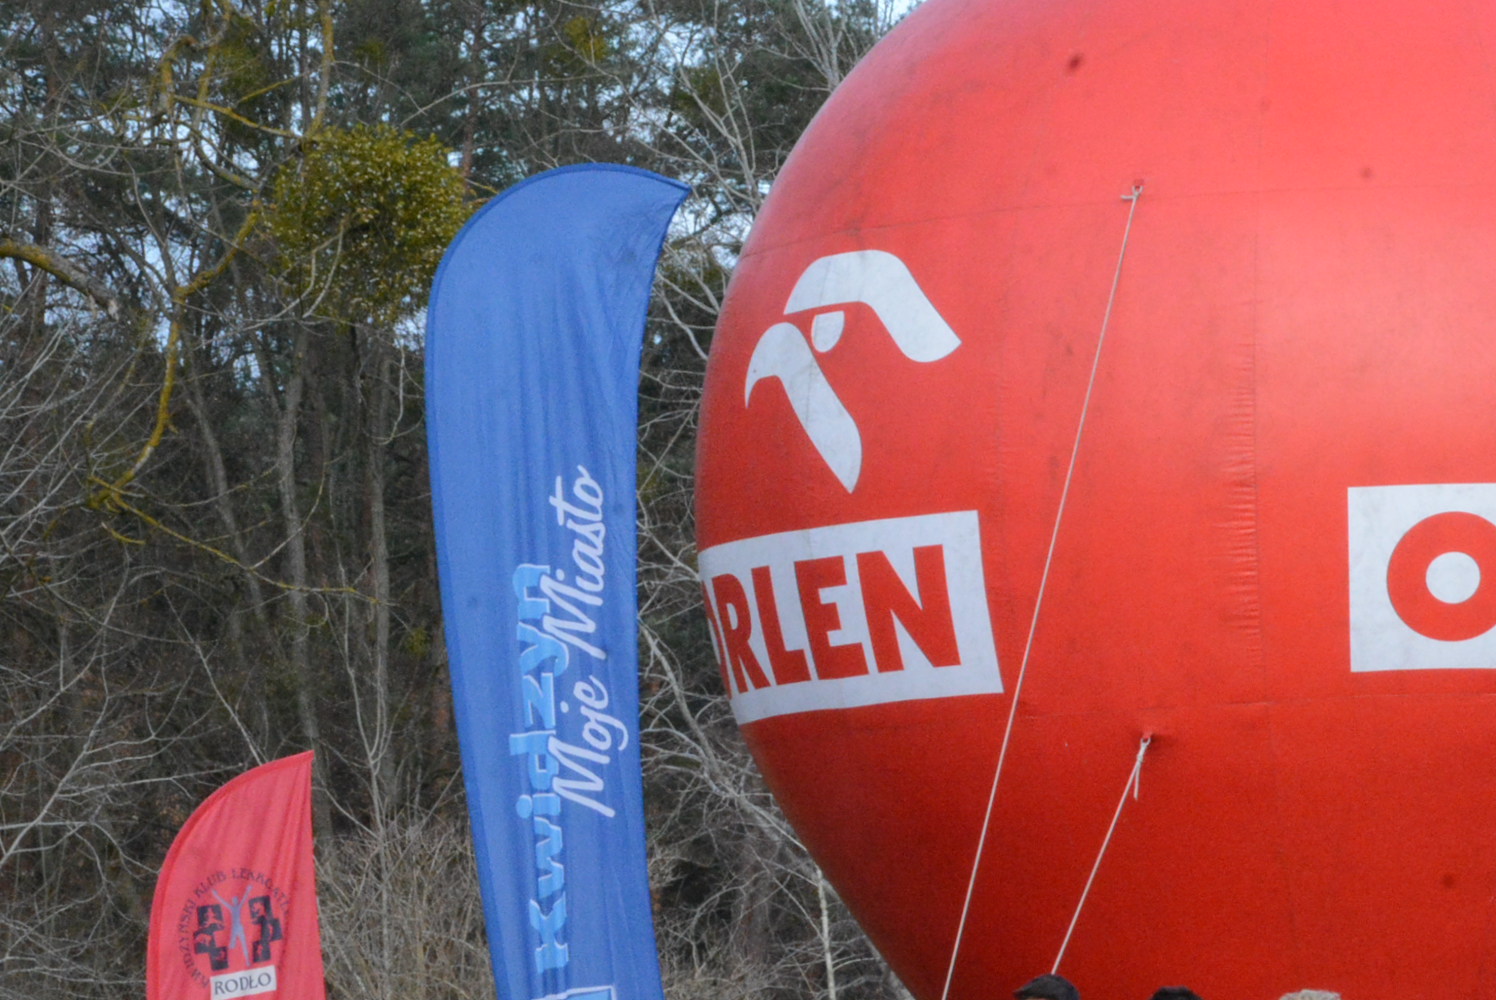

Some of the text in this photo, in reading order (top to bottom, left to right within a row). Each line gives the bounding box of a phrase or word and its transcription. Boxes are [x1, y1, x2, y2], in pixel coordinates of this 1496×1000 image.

[539, 464, 629, 818] Moje Miasto
[213, 972, 272, 996] RODŁO
